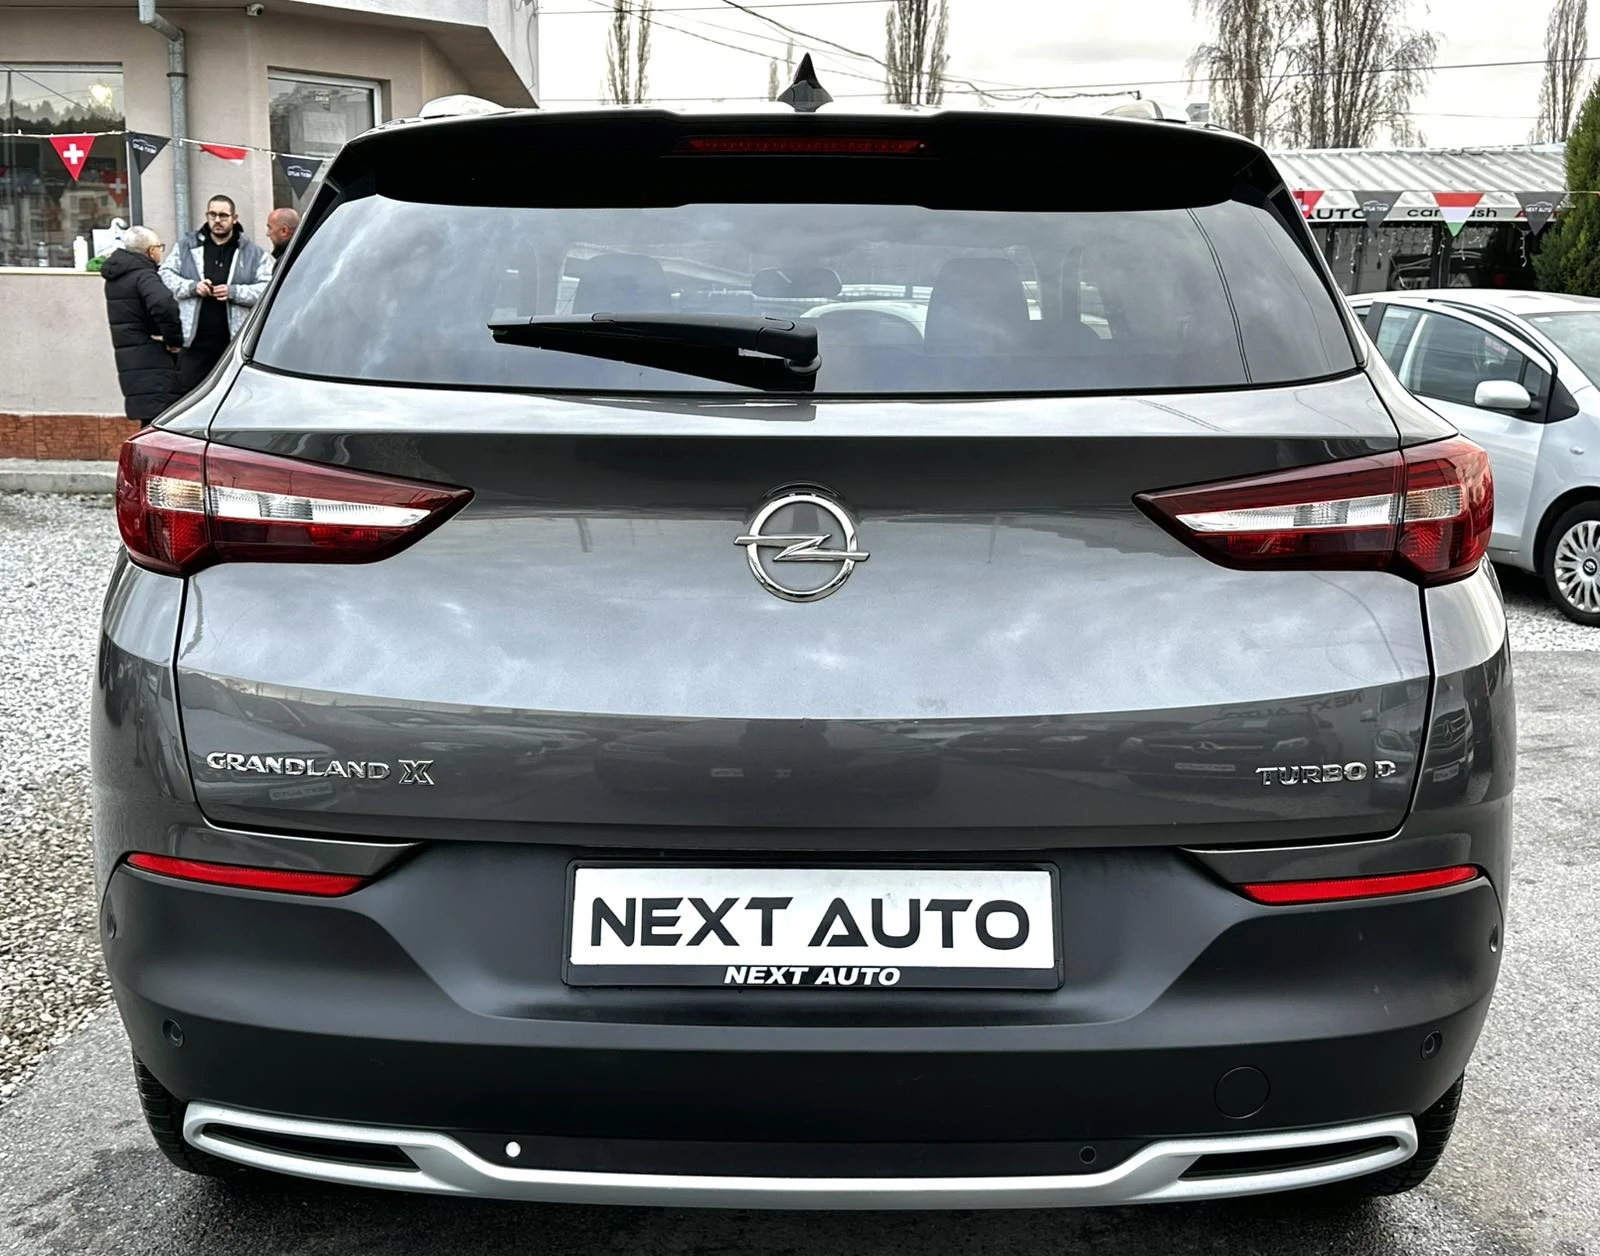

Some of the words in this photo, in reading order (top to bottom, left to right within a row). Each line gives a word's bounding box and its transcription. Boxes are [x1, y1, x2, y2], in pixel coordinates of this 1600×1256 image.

[1407, 208, 1440, 218] car
[206, 752, 391, 780] GRANDLAND
[398, 759, 435, 785] X
[1255, 761, 1367, 786] TURBO
[1374, 760, 1396, 779] D
[590, 896, 793, 947] NEXT
[807, 896, 1031, 951] AUTO
[724, 966, 813, 985] NEXT
[815, 966, 901, 986] AUTO
